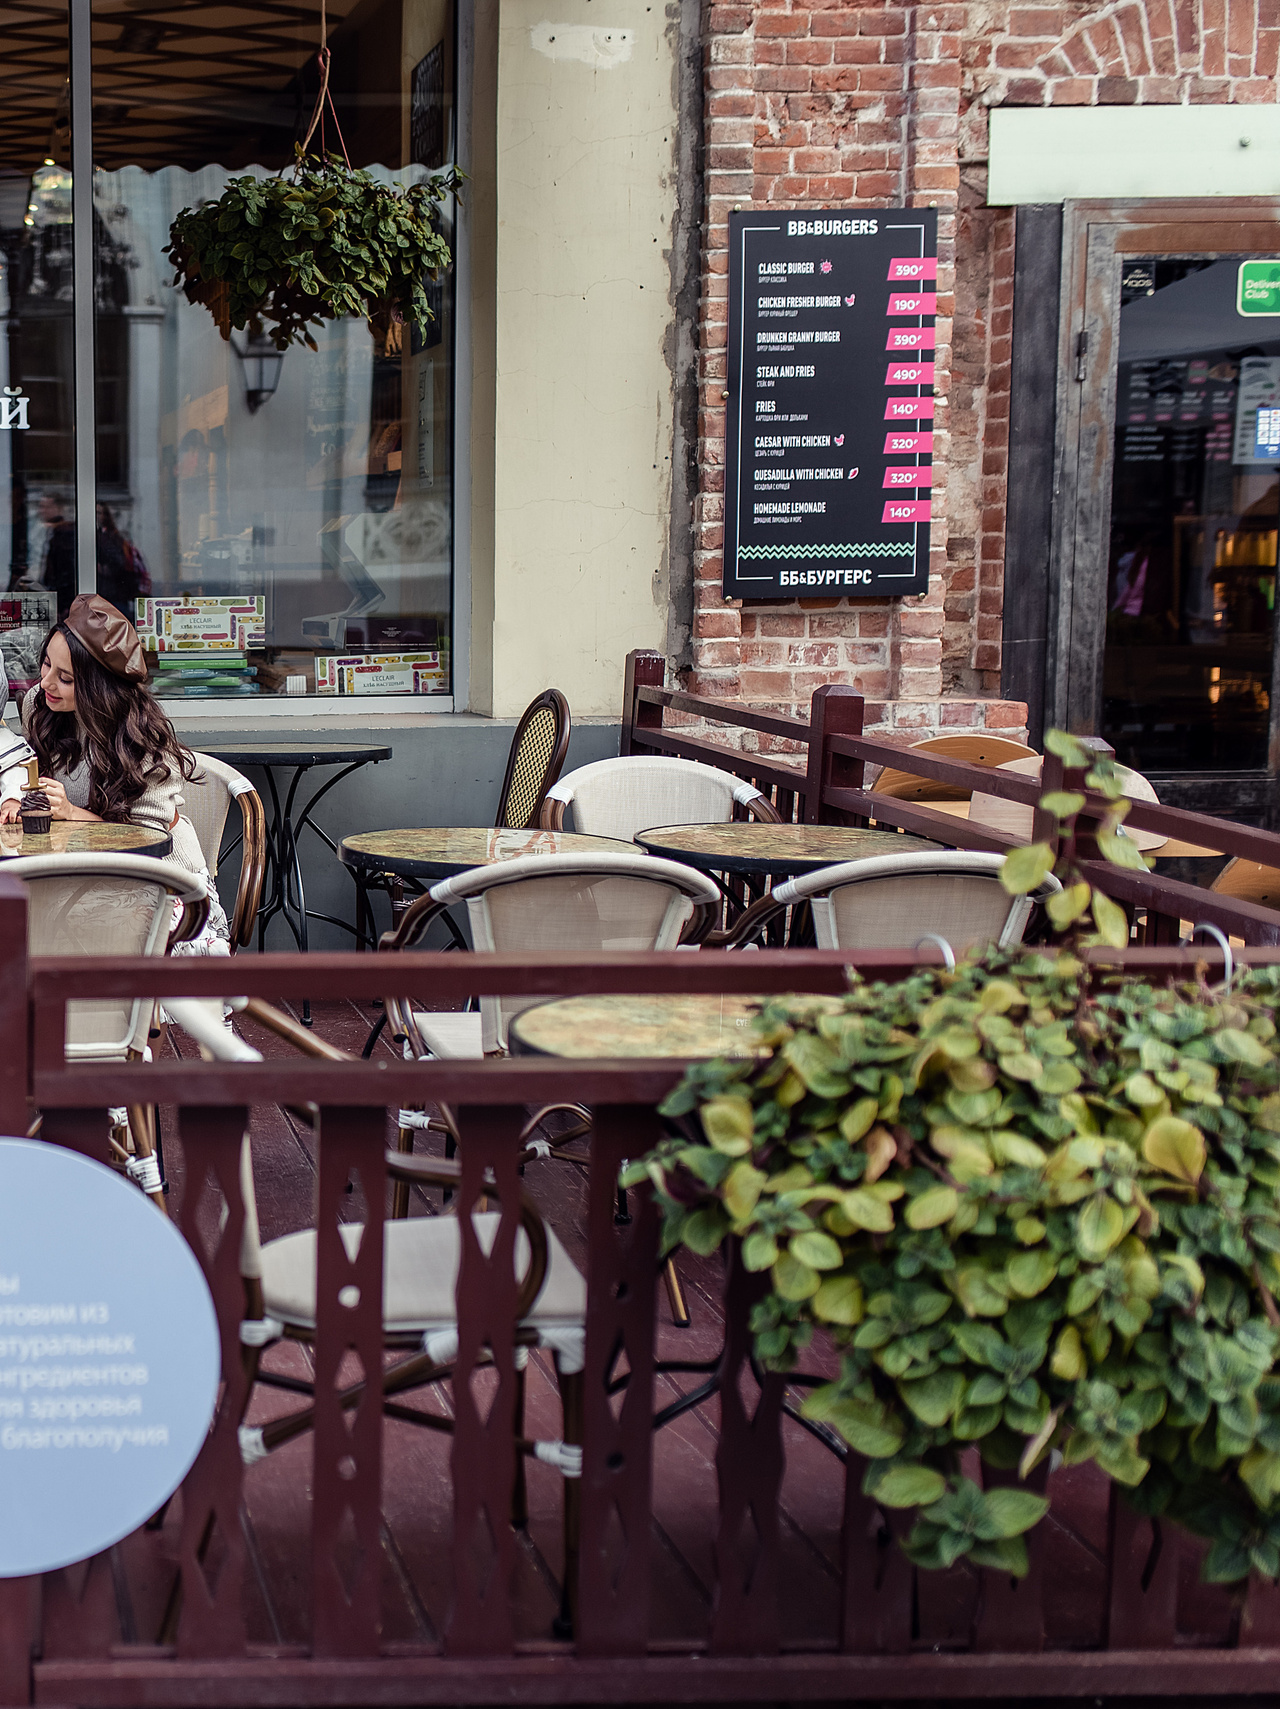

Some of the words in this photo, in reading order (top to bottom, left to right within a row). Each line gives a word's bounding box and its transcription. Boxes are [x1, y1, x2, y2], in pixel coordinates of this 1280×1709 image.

[787, 219, 878, 236] BB&BURGERS
[758, 263, 787, 275] CLASSIC
[788, 262, 814, 274] BURGER
[1245, 290, 1269, 299] Club
[758, 297, 786, 308] CHICKEN
[787, 296, 815, 308] FRESHER
[816, 296, 841, 307] BURGER
[757, 332, 787, 343] DRUNKEN
[789, 331, 815, 343] GRANNY
[815, 331, 840, 342] BURGER
[757, 366, 779, 378] STEAK
[780, 366, 795, 377] AND
[796, 365, 815, 377] FRIES
[756, 401, 776, 412] FRIES
[755, 436, 781, 447] CAESAR
[783, 436, 801, 447] WITH
[802, 435, 830, 447] CHICKEN
[754, 469, 795, 480] QUESADILLA
[796, 468, 814, 480] WITH
[815, 468, 843, 479] CHICKEN
[754, 503, 790, 514] HOMEMADE
[791, 502, 826, 513] LEMONADE
[780, 570, 872, 585] ББ&БУРГЕРС
[19, 757, 47, 791] 1
[79, 1303, 110, 1325] из
[28, 1394, 142, 1423] здоровья
[1, 1421, 168, 1453] благополучия
